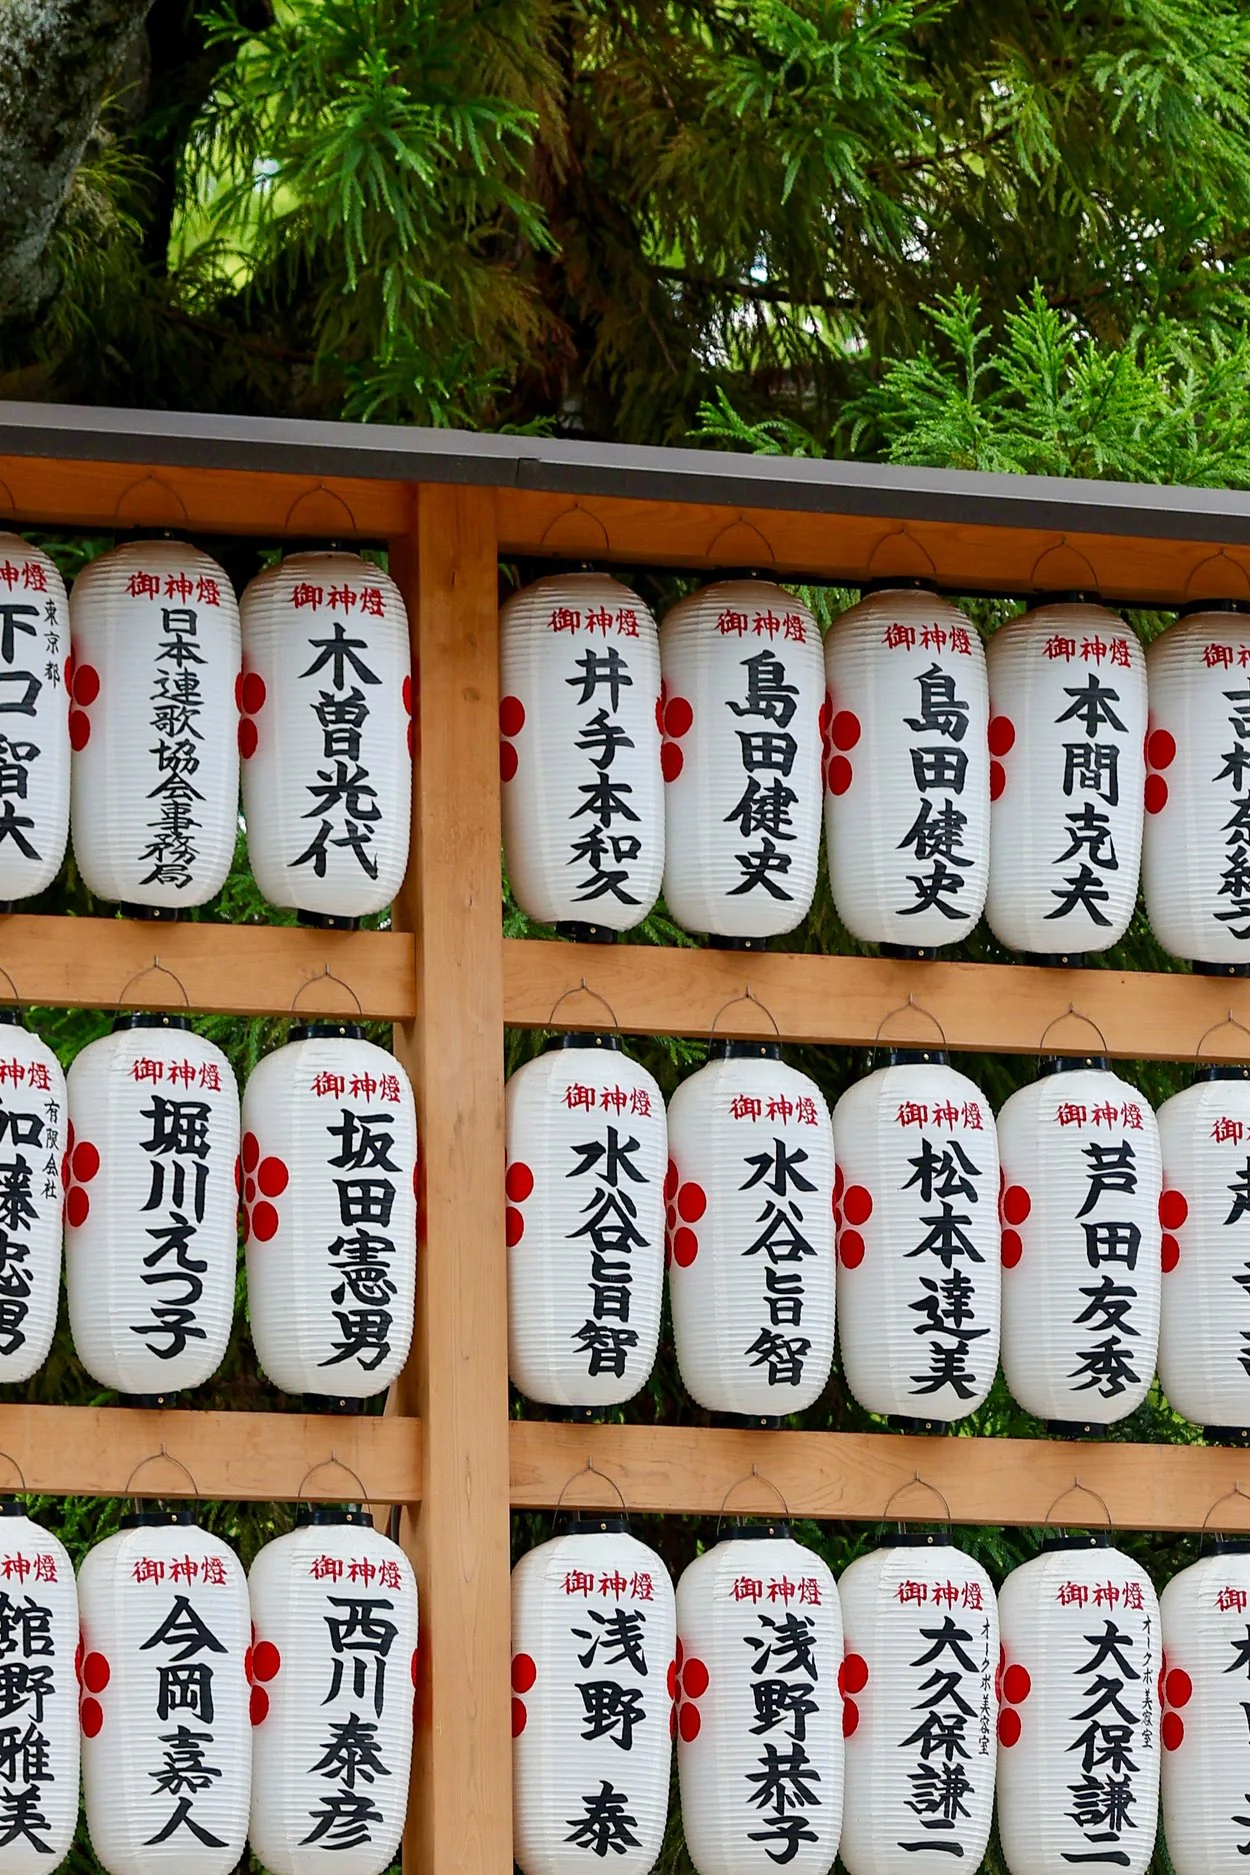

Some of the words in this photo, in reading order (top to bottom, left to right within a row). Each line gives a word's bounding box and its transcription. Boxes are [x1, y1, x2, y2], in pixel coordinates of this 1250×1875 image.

[43, 599, 61, 690] 東京都
[127, 571, 220, 607] 御神燈
[292, 583, 384, 617] 御神燈
[548, 605, 639, 637] 御神燈
[717, 609, 806, 643] 御神燈
[885, 624, 971, 655] 御神燈
[1050, 634, 1131, 668] 御神燈
[138, 608, 208, 889] 日本連歌協会事務局
[287, 623, 382, 880] 木曽光代
[565, 647, 643, 905] 井手本和久
[723, 650, 799, 901] 島田健史
[895, 663, 974, 919] 島田健史
[1045, 673, 1129, 929] 本間克夫
[131, 1058, 221, 1092] 御神燈
[313, 1072, 400, 1103] 御神燈
[565, 1084, 650, 1116] 御神燈
[731, 1095, 816, 1125] 御神燈
[897, 1101, 981, 1129] 御神燈
[1058, 1103, 1142, 1129] 御神燈
[40, 1099, 62, 1202] 有限会社
[129, 1095, 211, 1359] 堀川えつ子
[317, 1109, 404, 1372] 坂田憲男
[565, 1126, 653, 1380] 水谷旨智
[738, 1138, 818, 1386] 水谷旨智
[901, 1138, 993, 1401] 松本達美
[1067, 1140, 1145, 1400] 芦田友秀
[133, 1555, 225, 1584] 御神燈
[311, 1555, 400, 1589] 御神燈
[563, 1569, 653, 1600] 御神燈
[732, 1576, 820, 1605] 御神燈
[897, 1580, 982, 1610] 御神燈
[1058, 1582, 1142, 1609] 御神燈
[139, 1595, 229, 1847] 今岡嘉人
[298, 1596, 401, 1852] 西川泰彦
[563, 1608, 648, 1857] 浅野泰
[743, 1613, 822, 1864] 浅野恭子
[897, 1616, 979, 1857] 大久保謙二
[977, 1615, 992, 1758] オークボ美容室
[1061, 1620, 1140, 1866] 大久保謙二
[1141, 1616, 1155, 1751] オークボ美容室
